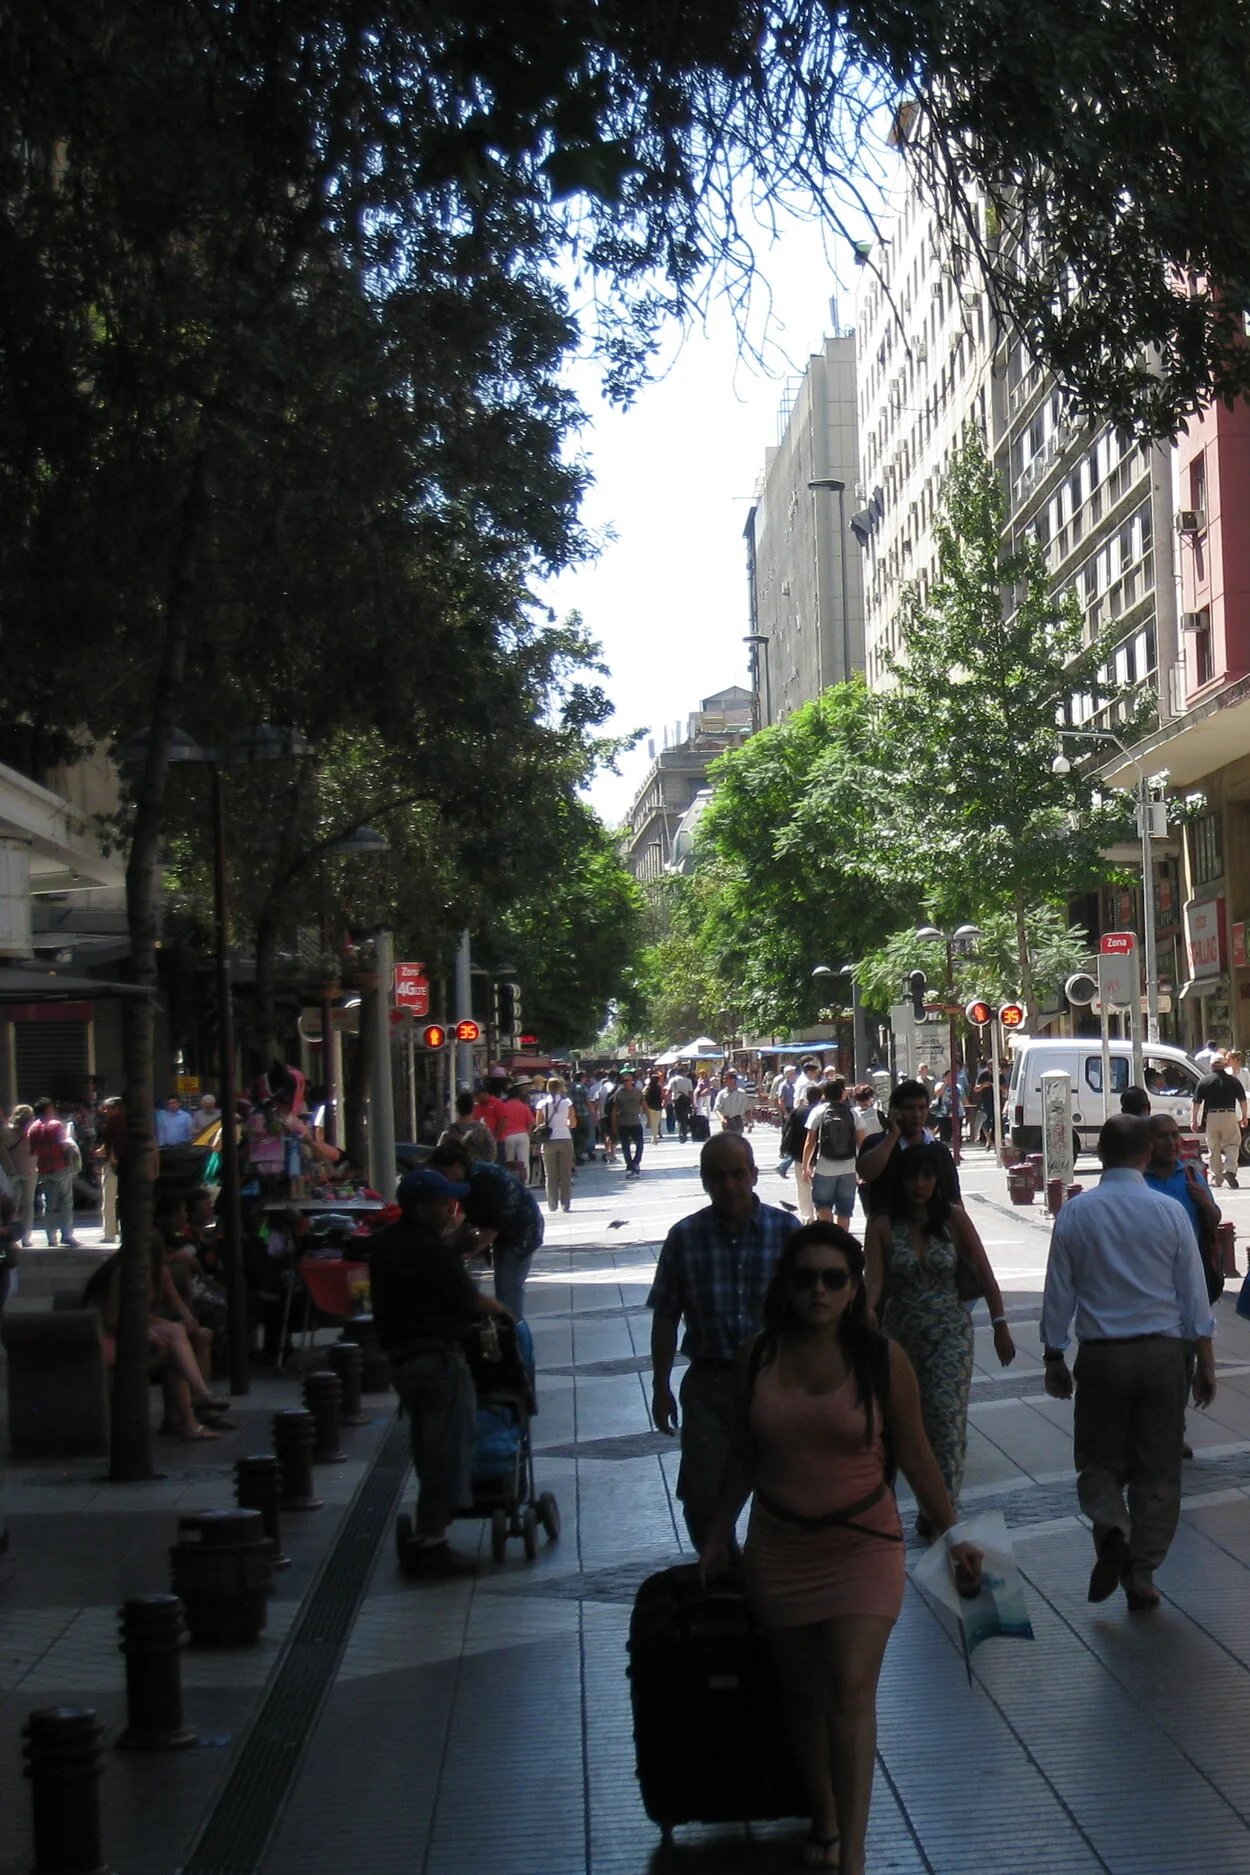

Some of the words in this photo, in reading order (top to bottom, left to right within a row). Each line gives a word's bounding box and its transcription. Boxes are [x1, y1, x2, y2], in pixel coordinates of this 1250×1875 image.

[1106, 938, 1128, 948] Zona
[1003, 1010, 1020, 1024] 35
[459, 1025, 477, 1040] 35
